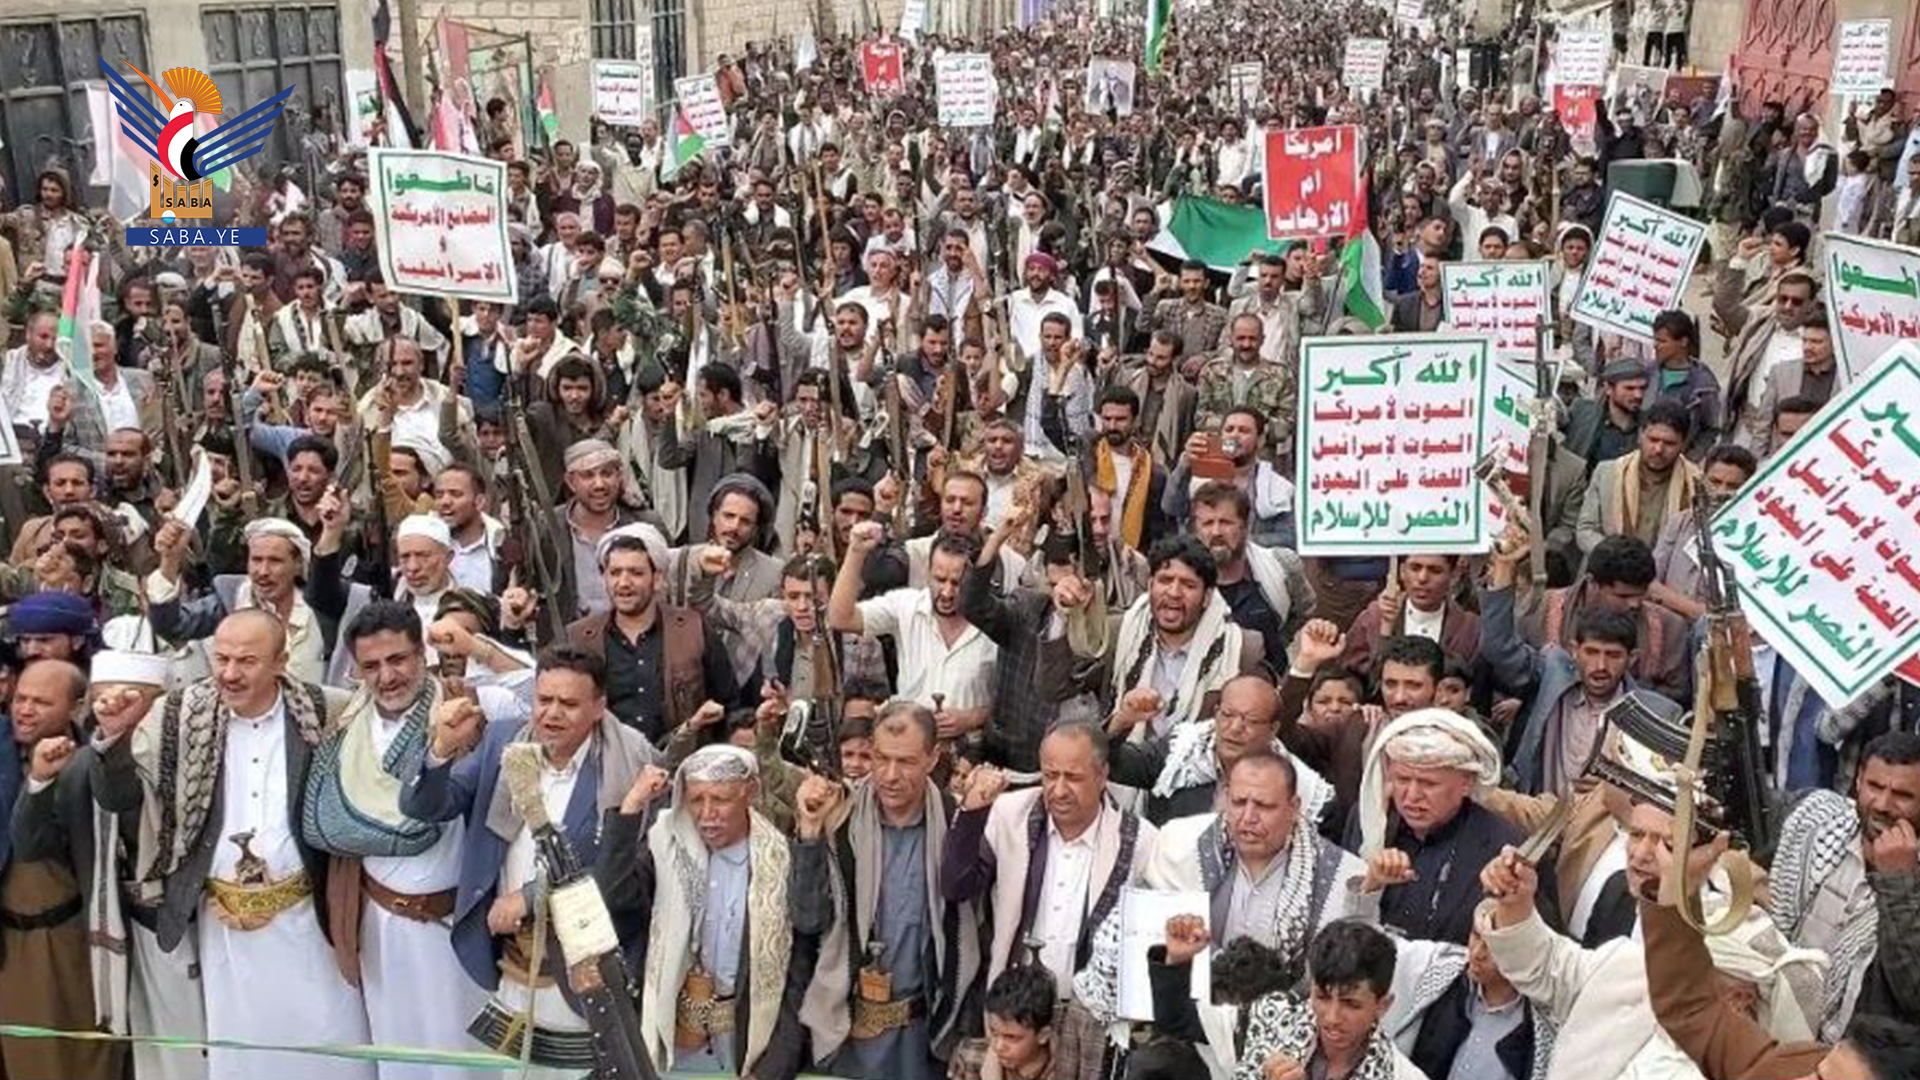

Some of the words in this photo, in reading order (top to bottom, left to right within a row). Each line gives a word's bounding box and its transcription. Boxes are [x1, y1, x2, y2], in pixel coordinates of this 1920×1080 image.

[386, 167, 495, 196] قاطعوا
[438, 235, 447, 253] و
[1314, 346, 1413, 397] أكبر
[1415, 352, 1478, 384] الله
[1313, 394, 1397, 426] لأمريكا
[1402, 398, 1474, 424] الموت
[1401, 432, 1473, 460] الموت
[1310, 469, 1370, 495] اليهود
[1376, 468, 1410, 495] على
[1418, 465, 1471, 489] اللعنة
[1310, 500, 1392, 538] للإسلام
[1399, 496, 1470, 535] النصر
[1754, 487, 1825, 547] اليهود
[1810, 550, 1856, 582] على
[1787, 603, 1883, 671] النصر
